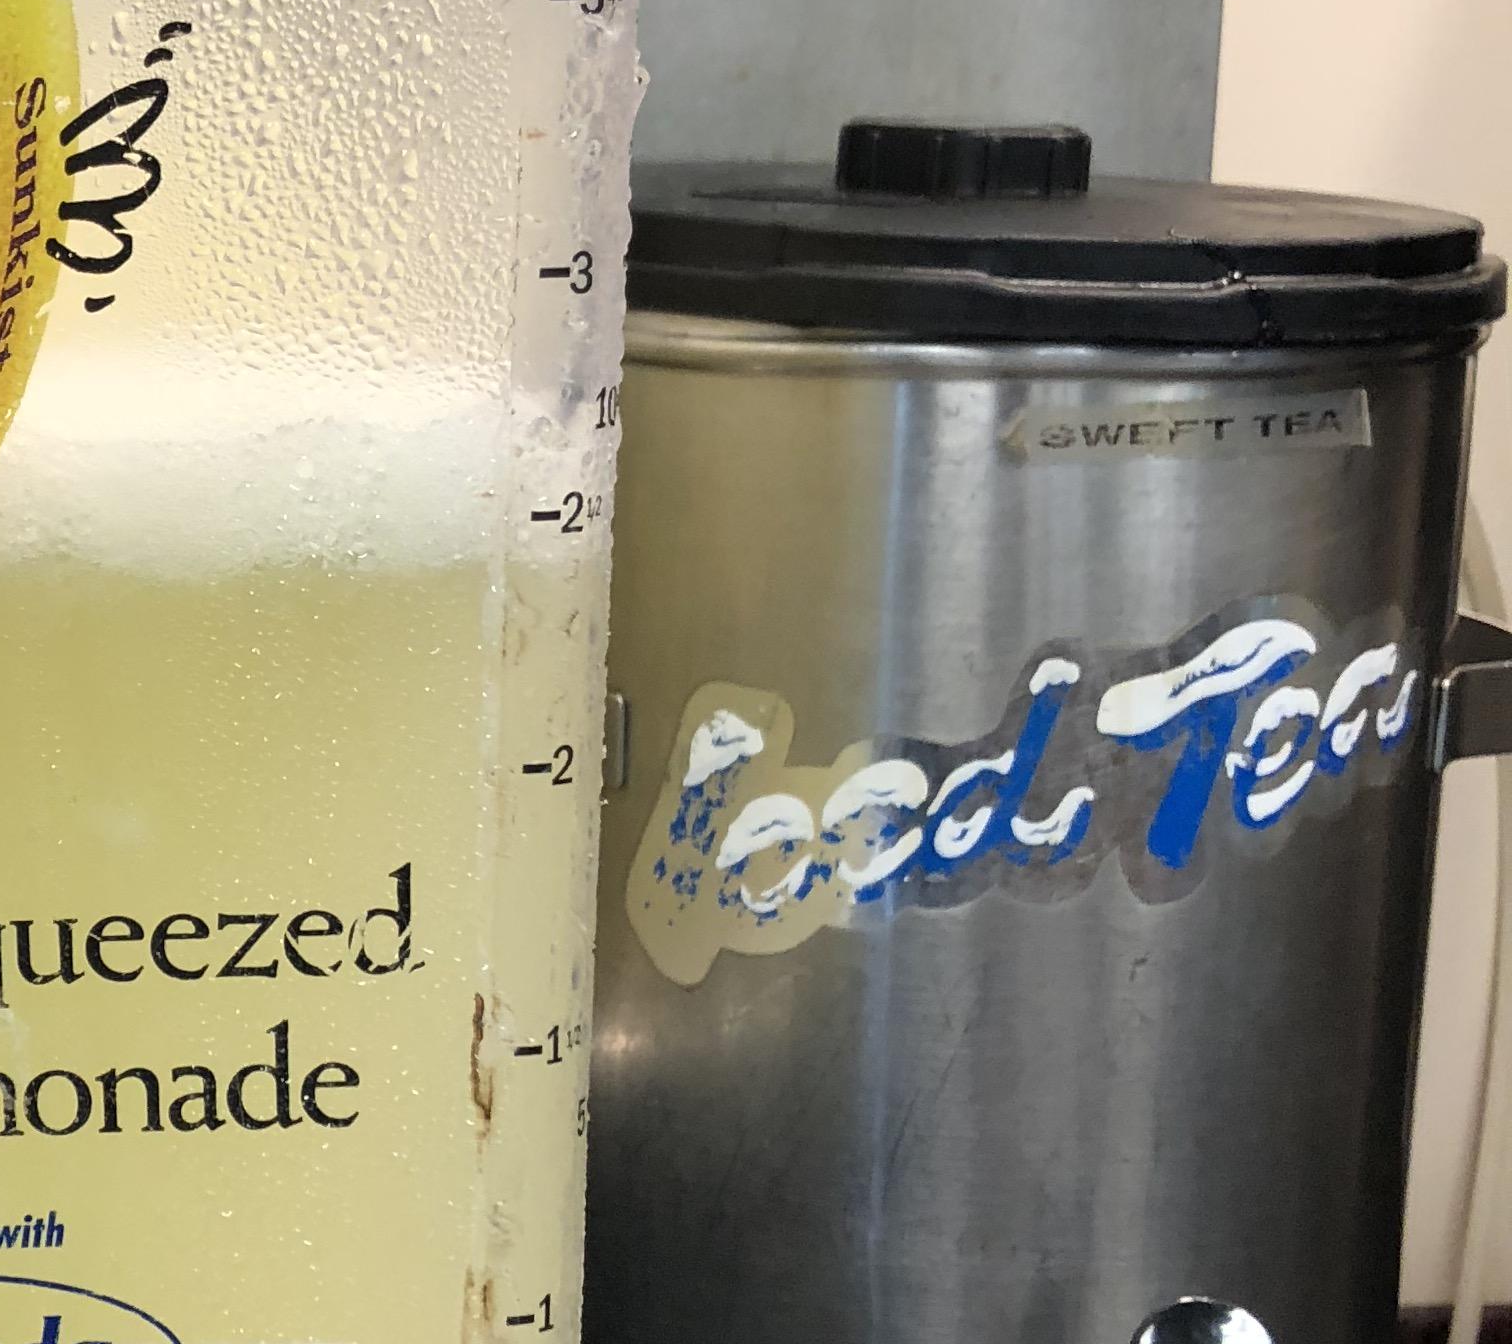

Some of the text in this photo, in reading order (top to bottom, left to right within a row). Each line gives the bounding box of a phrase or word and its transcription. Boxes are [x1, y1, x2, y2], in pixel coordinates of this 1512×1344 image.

[569, 250, 594, 295] 3
[1253, 408, 1343, 439] TEA
[551, 743, 575, 786] 2
[1097, 618, 1418, 870] Tea
[537, 1292, 556, 1334] 1
